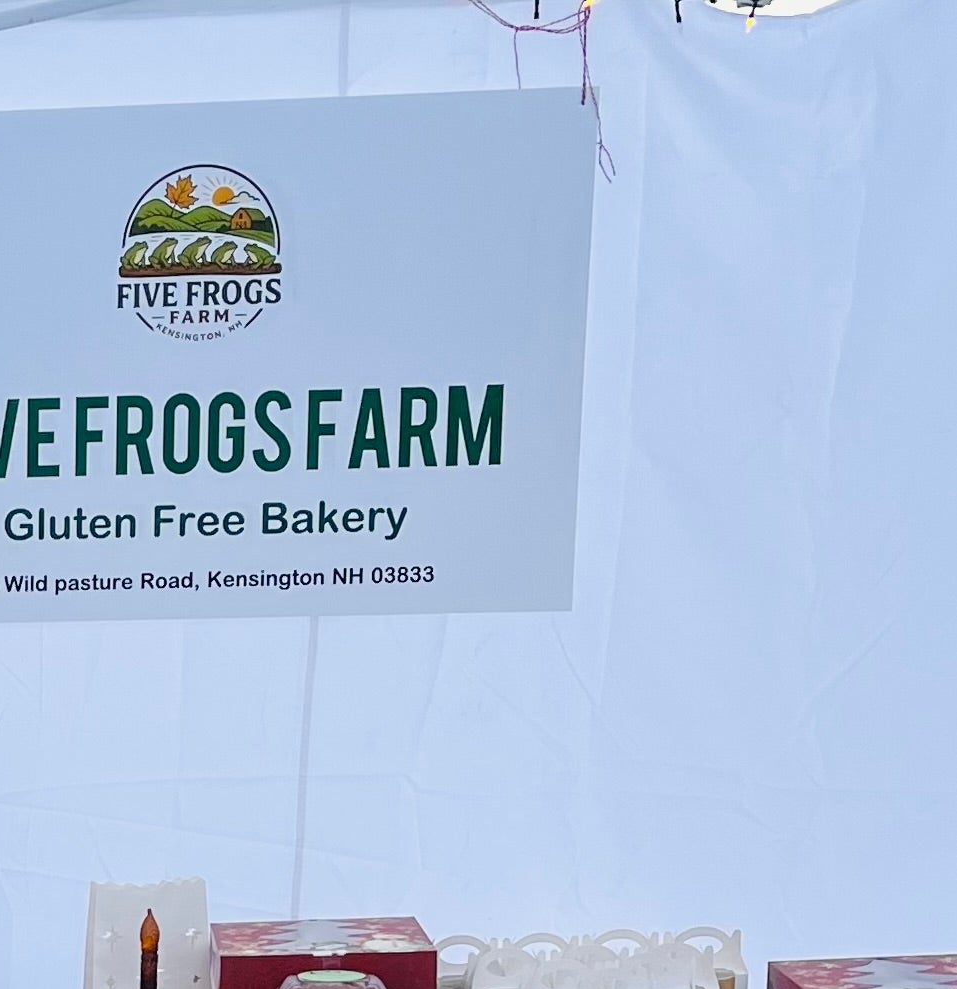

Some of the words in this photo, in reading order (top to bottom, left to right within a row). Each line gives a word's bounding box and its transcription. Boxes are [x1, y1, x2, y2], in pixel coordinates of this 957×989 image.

[117, 282, 178, 309] FIVE
[186, 278, 282, 307] FROGS
[169, 308, 230, 325] FARM
[228, 320, 243, 333] NH
[74, 390, 293, 477] FROGS
[306, 383, 505, 471] FARM
[4, 507, 137, 542] Gluten
[153, 504, 246, 538] Free
[261, 500, 408, 541] Bakery
[4, 574, 48, 593] Wild
[54, 576, 133, 597] pasture
[140, 571, 201, 594] Road,
[207, 569, 326, 592] Kensington
[332, 567, 364, 585] NH
[371, 565, 435, 585] 03833
